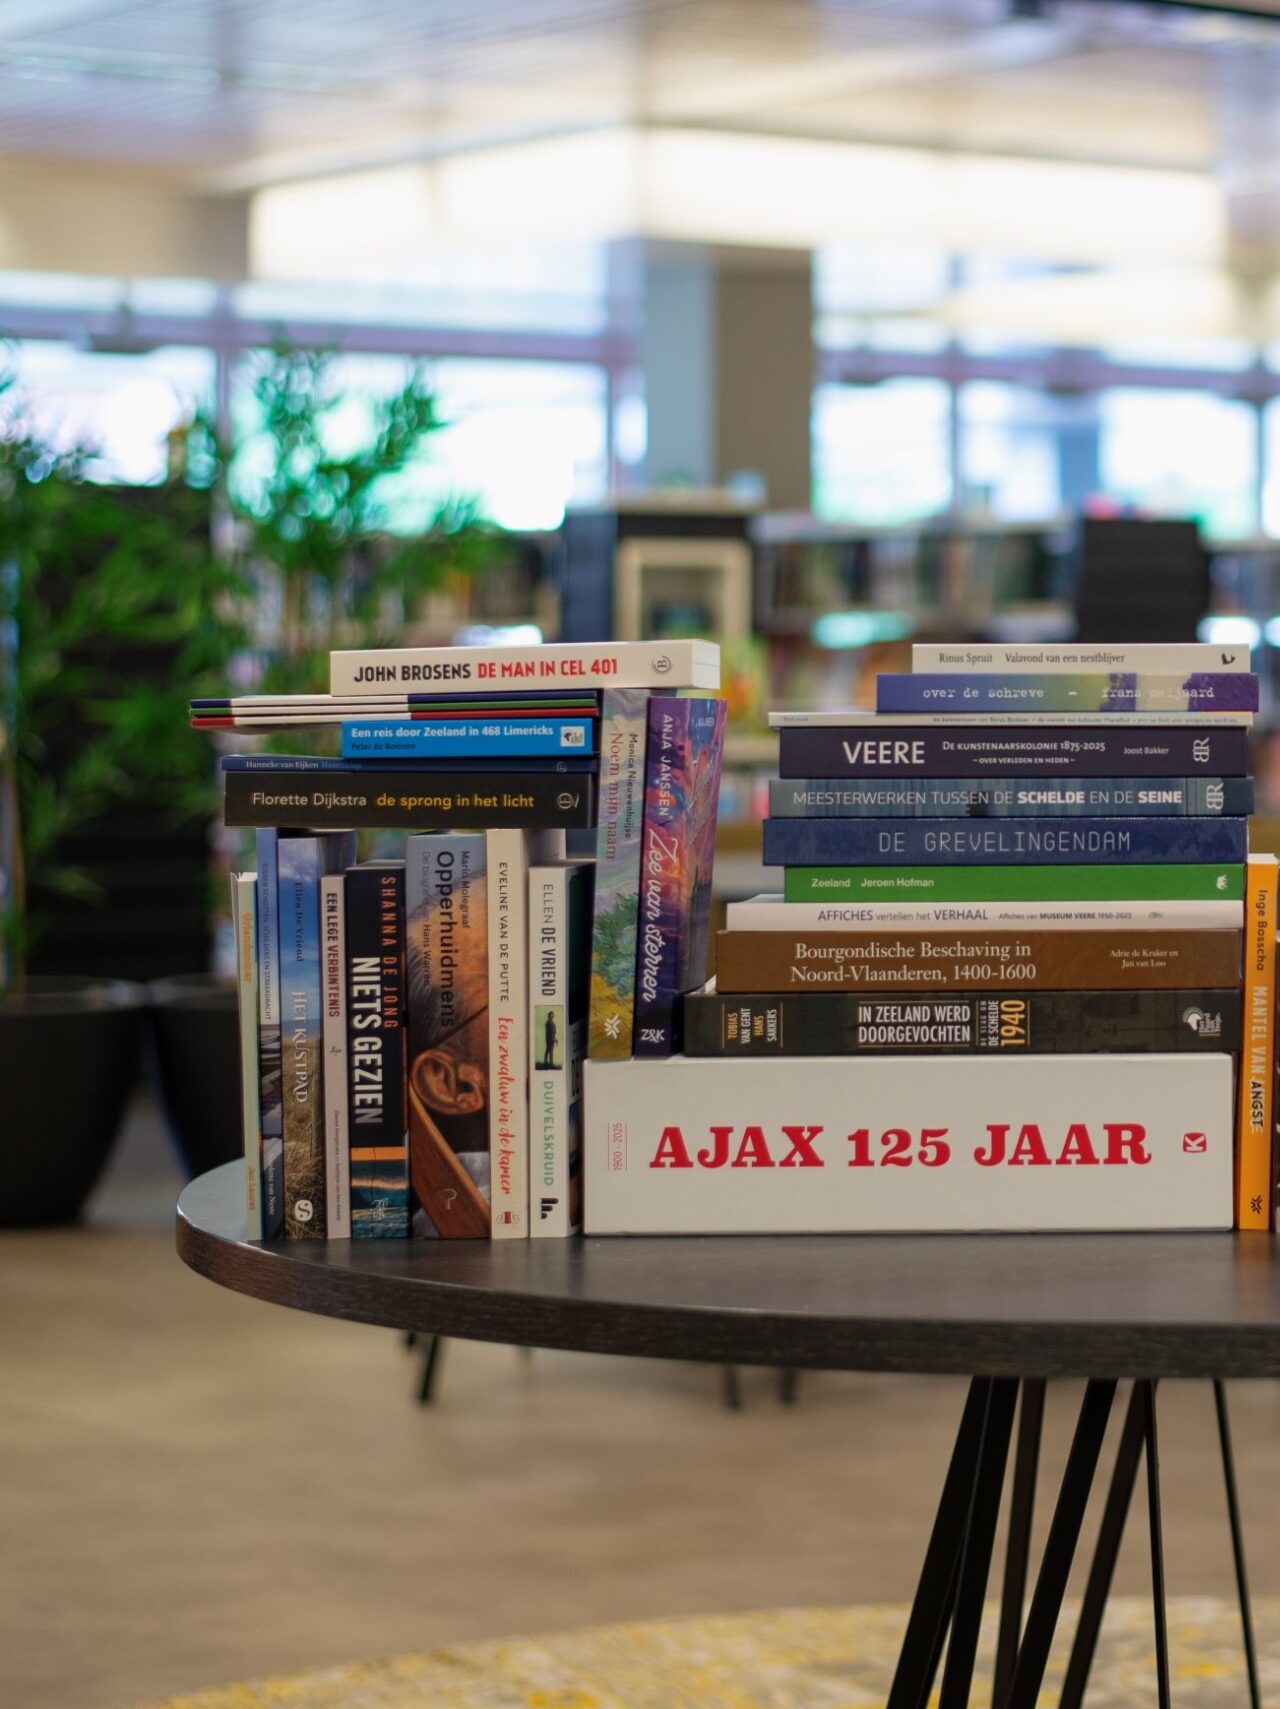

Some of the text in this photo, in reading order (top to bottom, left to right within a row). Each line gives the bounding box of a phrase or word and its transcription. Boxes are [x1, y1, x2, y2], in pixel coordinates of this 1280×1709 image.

[354, 658, 617, 682] JOHN BROSENS DE MAN IN CEL 401
[939, 653, 963, 662] Rinus
[966, 653, 992, 665] Spruit
[1005, 653, 1043, 662] Valavond
[1063, 655, 1078, 663] een
[1080, 652, 1125, 665] nestblijver
[352, 728, 371, 738] Een
[374, 727, 393, 738] reis
[396, 726, 421, 737] door
[424, 726, 466, 737] Zeeland
[469, 726, 479, 736] in
[482, 726, 501, 736] 468
[504, 725, 554, 736] Limericks
[843, 741, 925, 764] VEERE
[1123, 746, 1169, 755] Joost Bakker
[246, 760, 279, 769] Hanneke
[296, 761, 319, 771] Eijken
[659, 714, 673, 817] ANJA JANSSEN
[252, 791, 534, 811] Florette Dijkstra de sprong in het licht
[605, 732, 623, 859] Noem mijn naam
[793, 791, 1182, 804] MEESTERWERKEN TUSSEN DE SCHELDE EN DE SEINE
[879, 831, 1131, 853] DE GREVELINGENDAM
[811, 877, 934, 888] Zeeland Jeroen Hofman
[642, 828, 678, 1003] Zee van sterren
[435, 851, 459, 1027] Opperhuidmens
[326, 893, 340, 1017] EEN LEGE VERBINTENIS
[381, 877, 398, 1029] SHANNA DE JONG
[795, 941, 1031, 962] Bourgondische Beschaving in
[791, 964, 1037, 984] Noord-Vlaanderen, 1400-1600
[858, 1005, 970, 1022] IN ZEELAND WERD
[1000, 1000, 1026, 1047] 1940
[541, 883, 556, 1187] ELLEN DE VRIEND DUIVELSKRUID
[727, 1012, 738, 1040] TOBIAS
[741, 1008, 751, 1044] VAN GENT
[754, 1015, 764, 1037] HANS
[767, 1009, 777, 1042] SAKKERS
[858, 1024, 970, 1043] DOORGEVOCHTEN
[352, 957, 383, 1124] NIETS GEZIEN
[649, 1123, 1153, 1169] AJAX 125 JAAR
